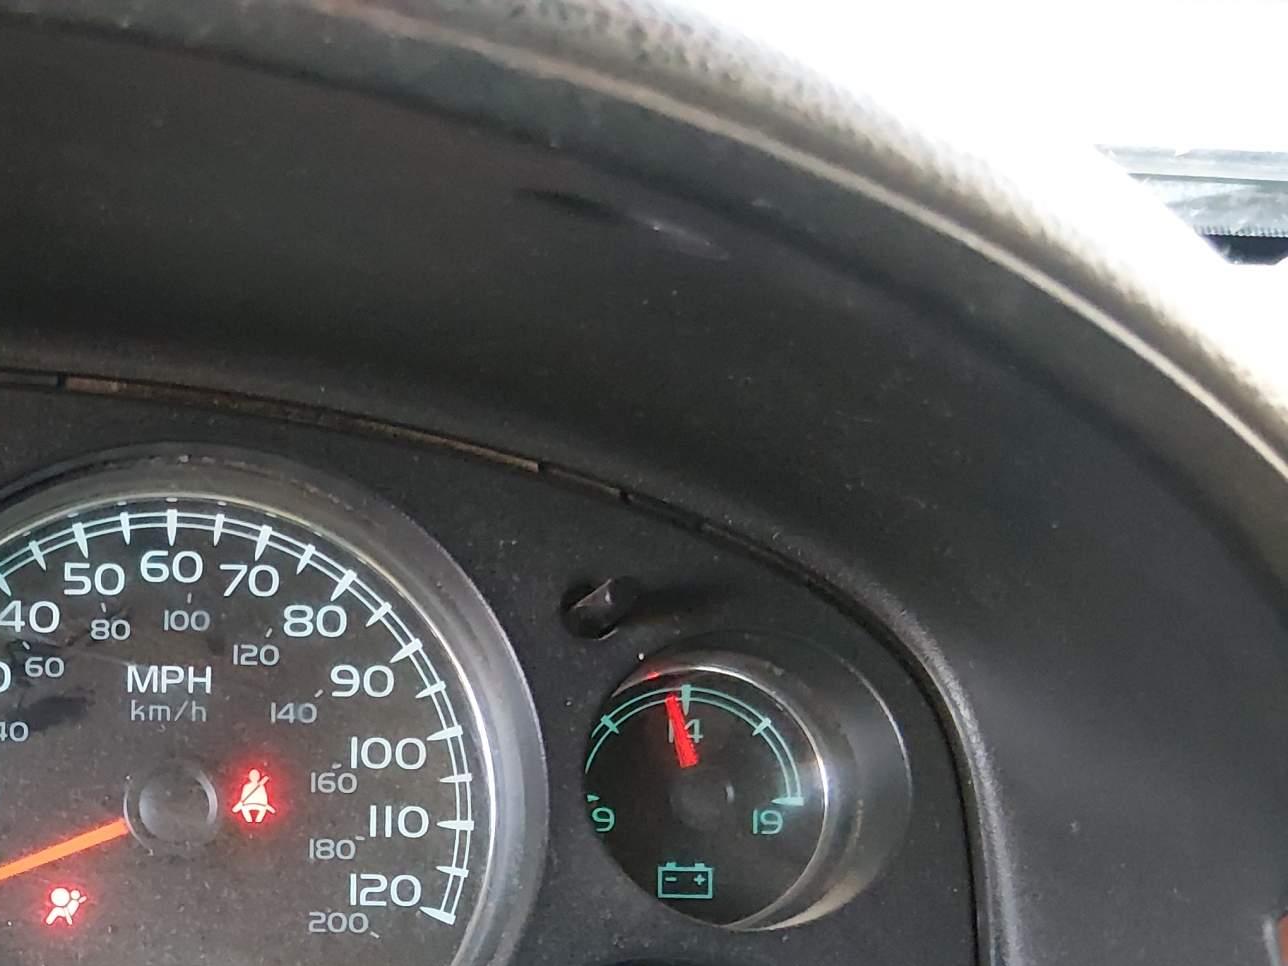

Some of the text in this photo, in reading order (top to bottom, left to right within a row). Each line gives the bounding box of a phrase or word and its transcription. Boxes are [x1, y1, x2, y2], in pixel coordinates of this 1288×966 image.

[63, 562, 125, 596] 50
[140, 550, 203, 583] 60
[219, 564, 280, 597] 70
[90, 619, 131, 641] 80
[163, 609, 210, 631] 100
[283, 604, 347, 638] 80
[24, 656, 65, 678] 60
[233, 644, 280, 666] 120
[127, 664, 212, 694] MPH
[330, 664, 395, 698] 90
[130, 699, 207, 722] km/h
[270, 702, 318, 724] 140
[350, 736, 427, 770] 100
[310, 772, 358, 794] 160
[369, 805, 430, 838] 110
[591, 807, 615, 832] 9
[752, 809, 784, 835] 19
[309, 838, 356, 860] 180
[349, 873, 422, 907] 120
[308, 911, 369, 933] 200
